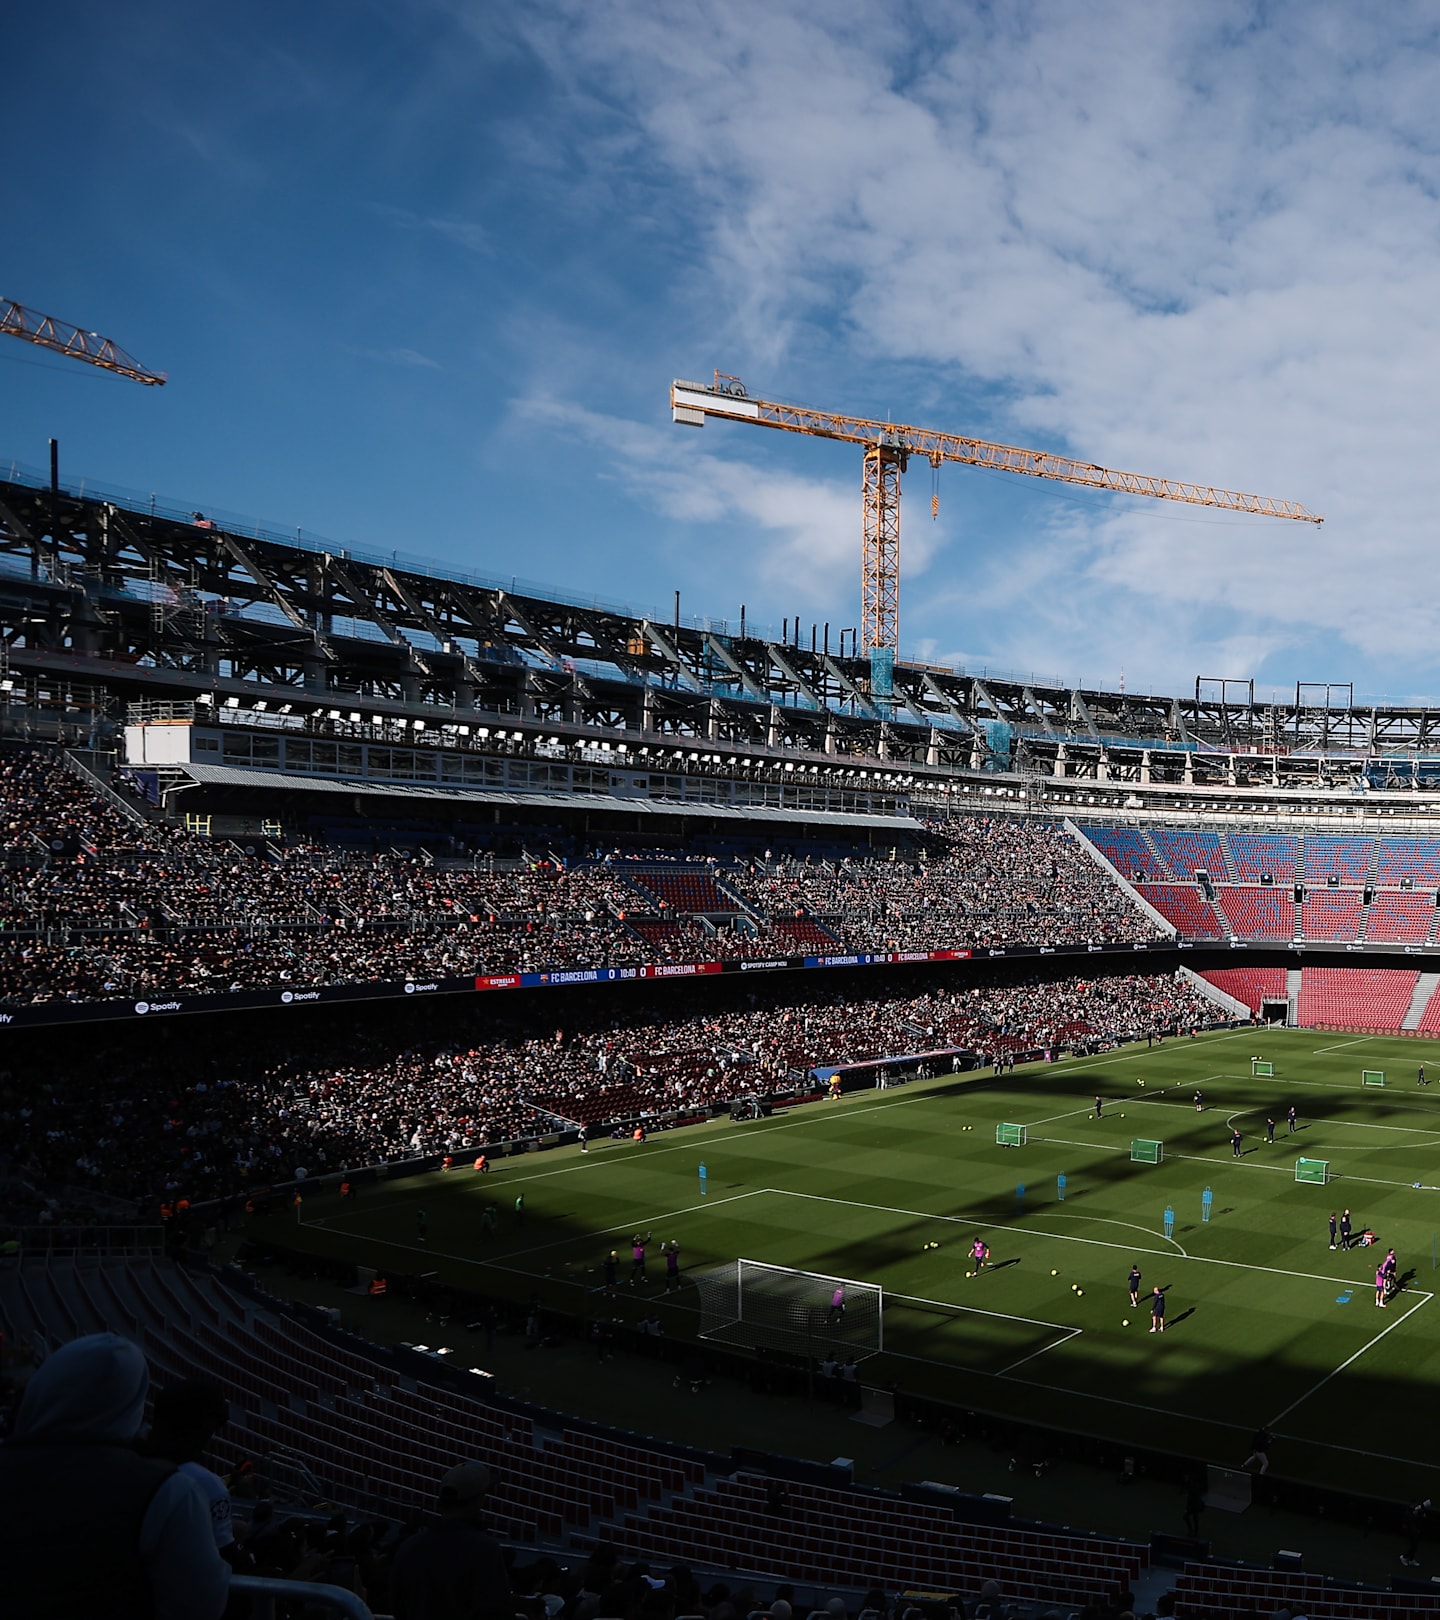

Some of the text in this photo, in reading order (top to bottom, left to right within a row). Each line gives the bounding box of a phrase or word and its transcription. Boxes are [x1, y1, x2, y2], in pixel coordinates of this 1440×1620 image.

[551, 974, 560, 982] FC
[560, 970, 597, 982] BARCELONA
[608, 970, 615, 979] 0
[640, 966, 646, 976] 0
[663, 965, 696, 975] BARCELONA
[294, 992, 320, 1001] Spotify
[150, 1002, 182, 1012] Spotify
